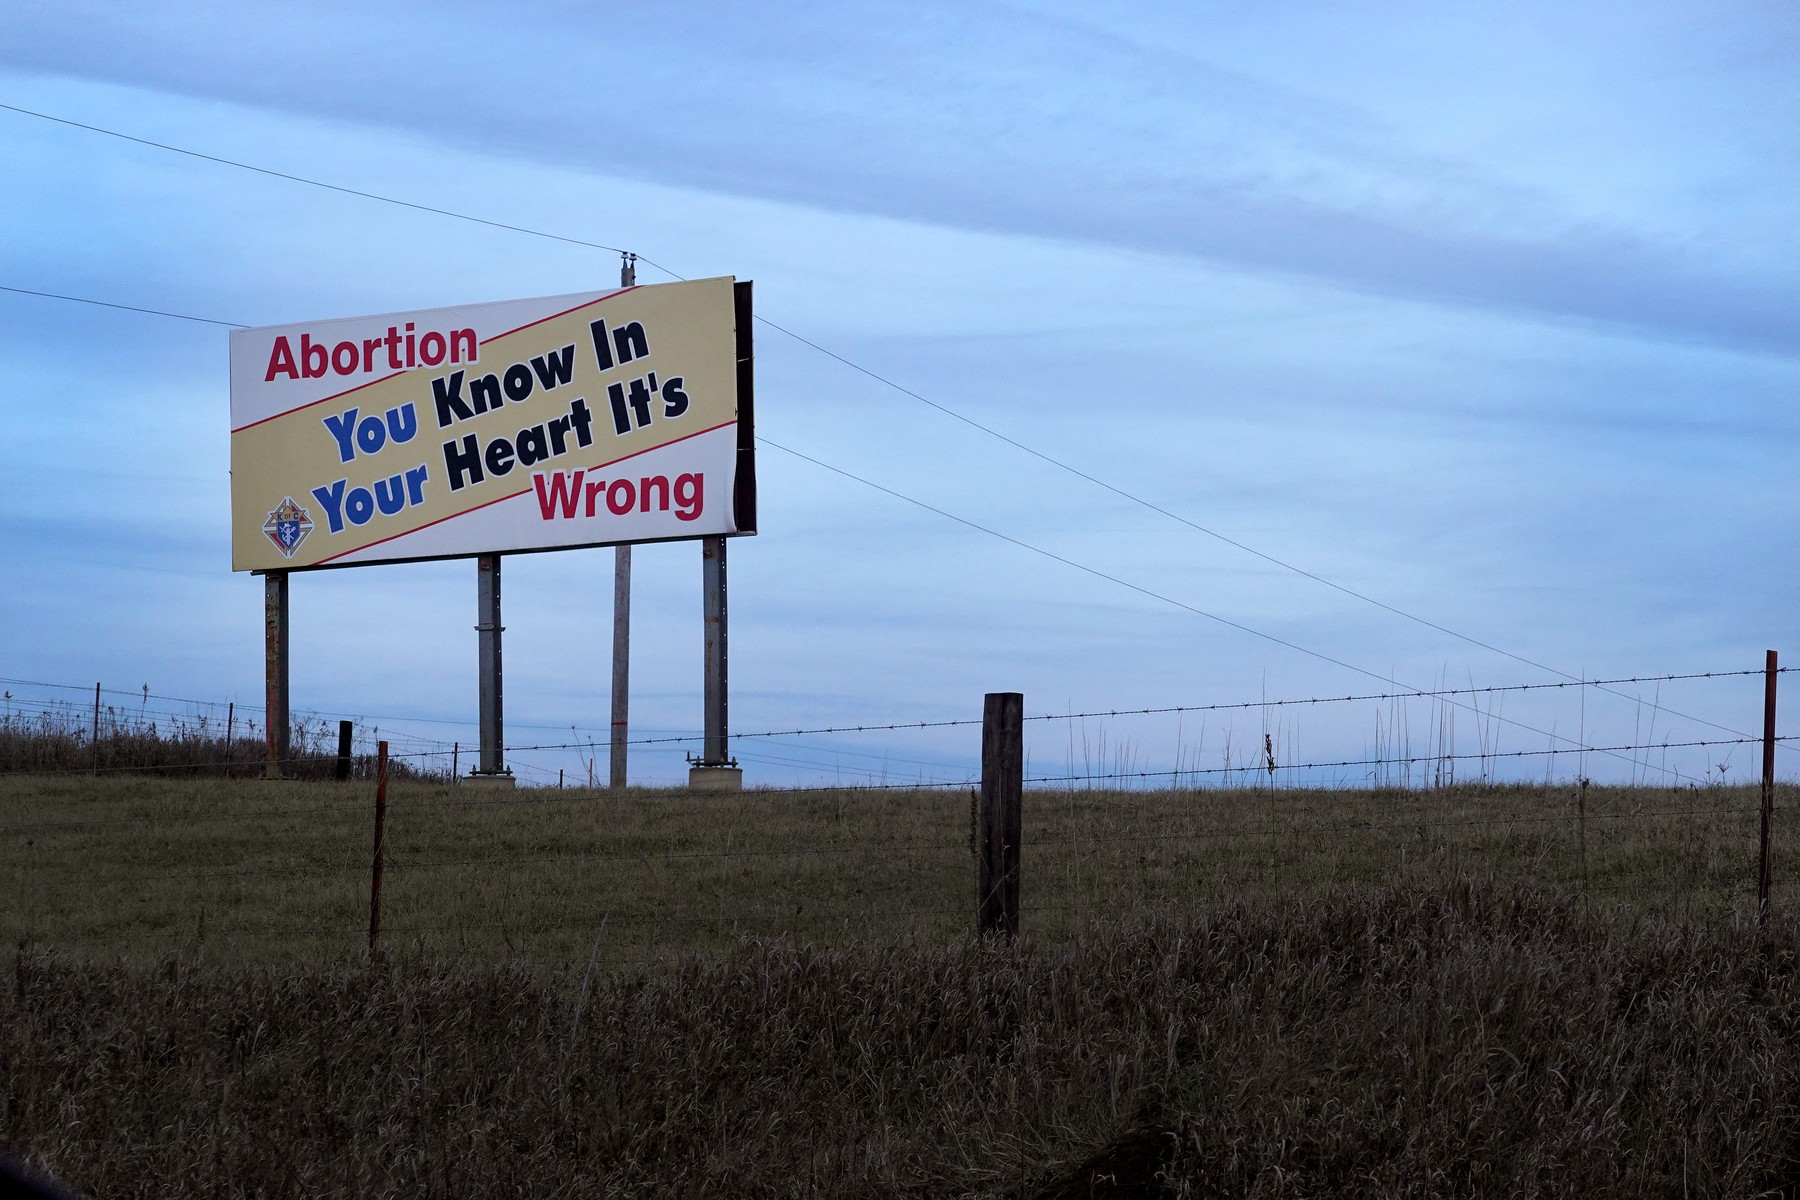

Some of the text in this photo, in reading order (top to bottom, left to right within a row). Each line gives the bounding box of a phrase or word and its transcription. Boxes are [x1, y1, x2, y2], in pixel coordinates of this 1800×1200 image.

[264, 322, 477, 382] Abortion
[323, 319, 650, 462] You Know In
[312, 372, 689, 534] Your Heart It's
[277, 513, 283, 521] K
[293, 512, 299, 520] C
[533, 471, 704, 520] Wrong
